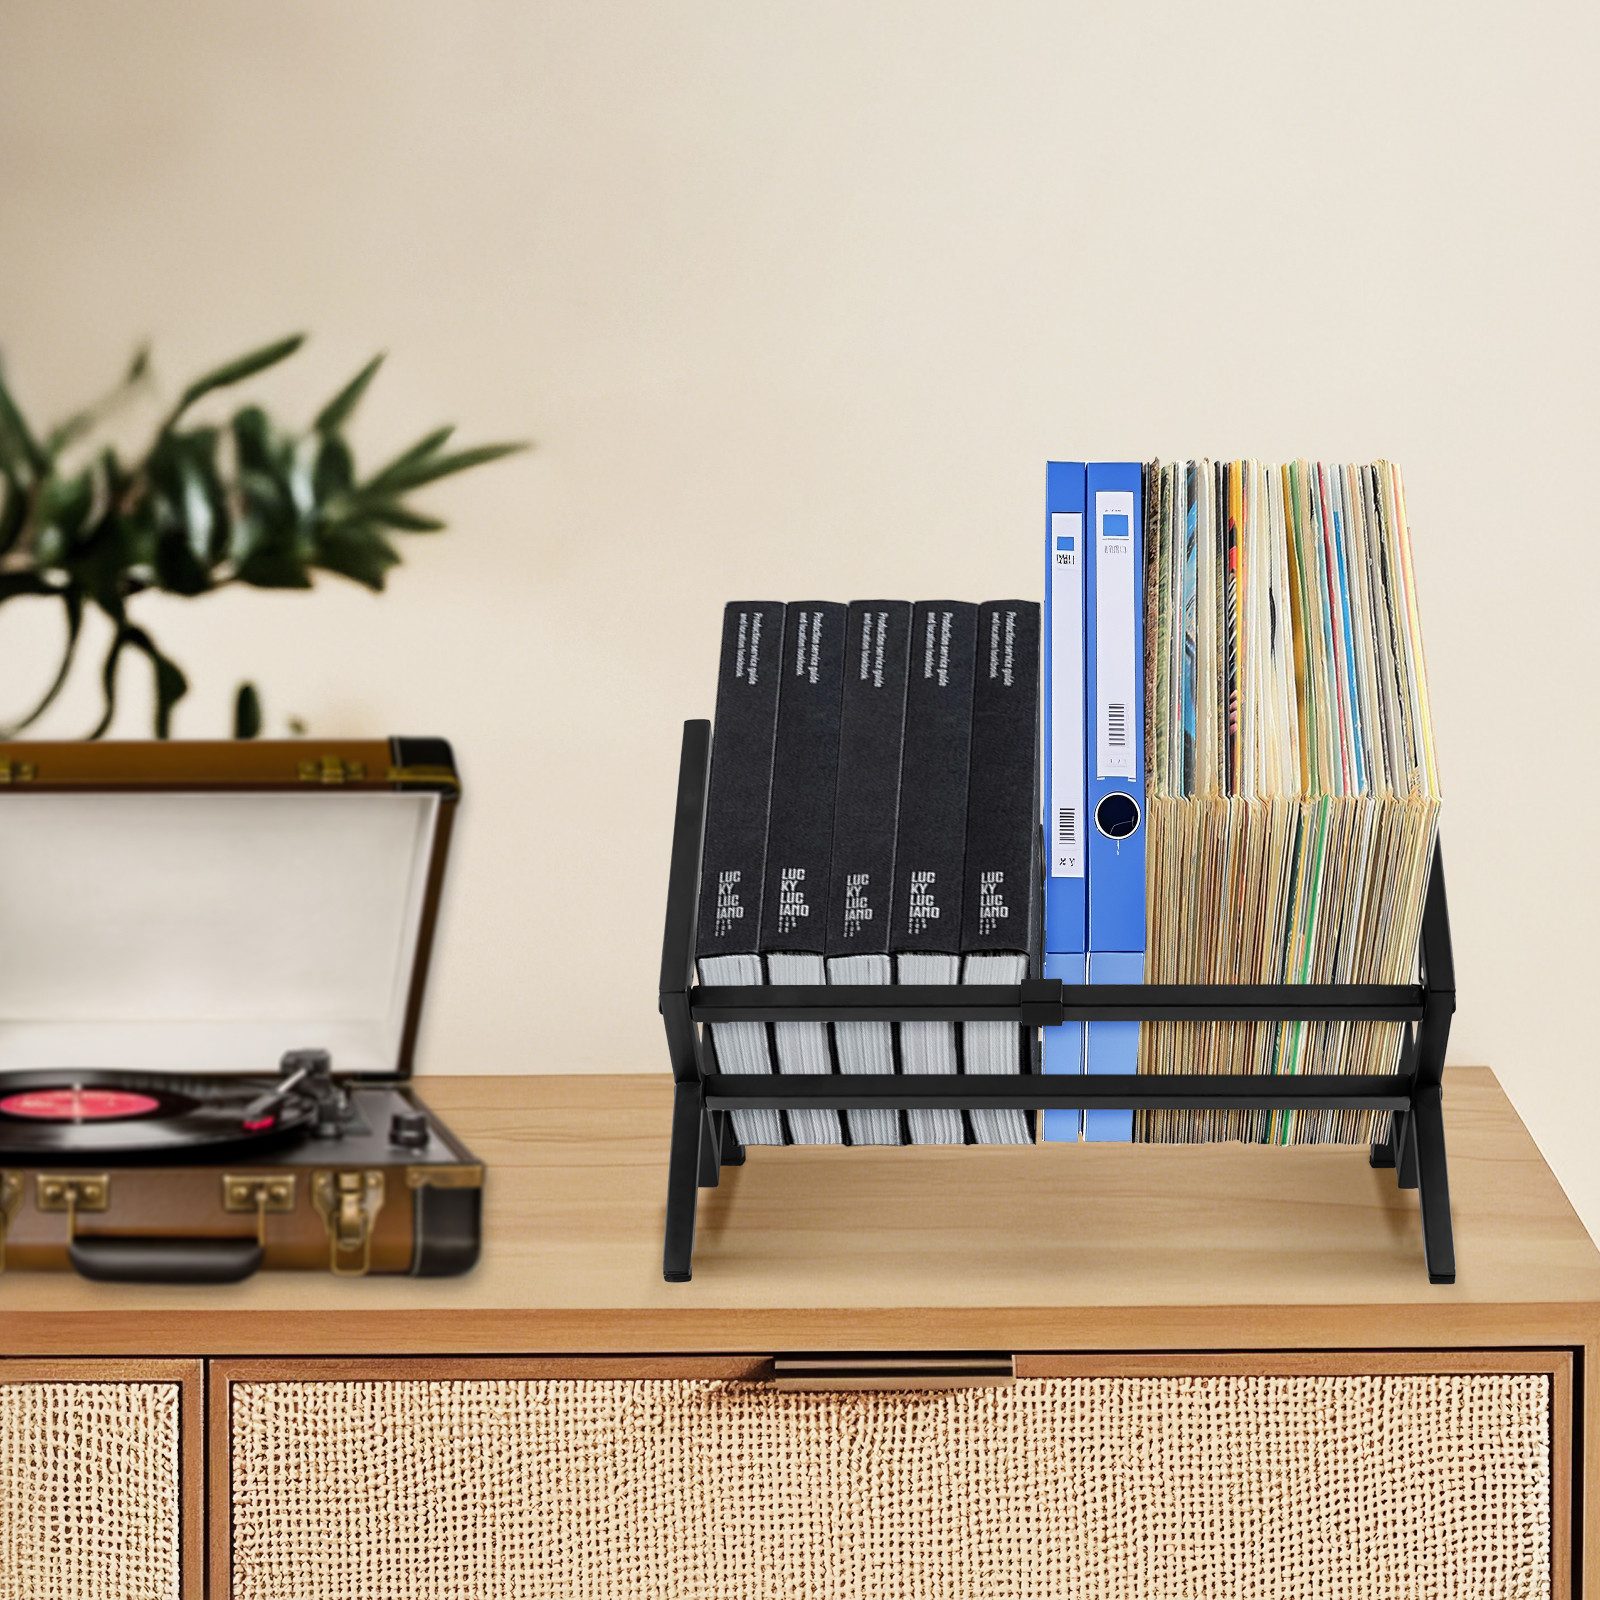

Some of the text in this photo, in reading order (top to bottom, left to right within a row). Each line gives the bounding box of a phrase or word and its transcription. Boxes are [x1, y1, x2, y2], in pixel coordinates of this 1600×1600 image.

[750, 645, 759, 666] service
[811, 645, 820, 665] service
[875, 647, 885, 668] service
[940, 646, 950, 668] service
[1005, 646, 1014, 667] service
[747, 668, 758, 685] guide
[808, 666, 819, 683] guide
[873, 670, 884, 687] guide
[937, 669, 949, 686] guide
[1002, 669, 1014, 686] guide
[719, 871, 741, 882] LUC
[782, 868, 805, 880] LUC
[847, 874, 869, 885] LUC
[912, 871, 935, 883] LUC
[981, 872, 1003, 883] LUC
[719, 883, 734, 895] KY
[781, 880, 798, 891] KY
[846, 885, 862, 897] KY
[911, 883, 928, 894] KY
[981, 883, 996, 894] KY
[718, 895, 739, 906] LUC
[780, 892, 804, 904] LUC
[846, 897, 868, 908] LUC
[910, 895, 934, 906] LUC
[981, 895, 1003, 906] LUC
[717, 907, 744, 919] IANO
[780, 904, 809, 916] IANO
[845, 909, 872, 920] IANO
[909, 906, 940, 918] IANO
[980, 906, 1009, 918] IANO
